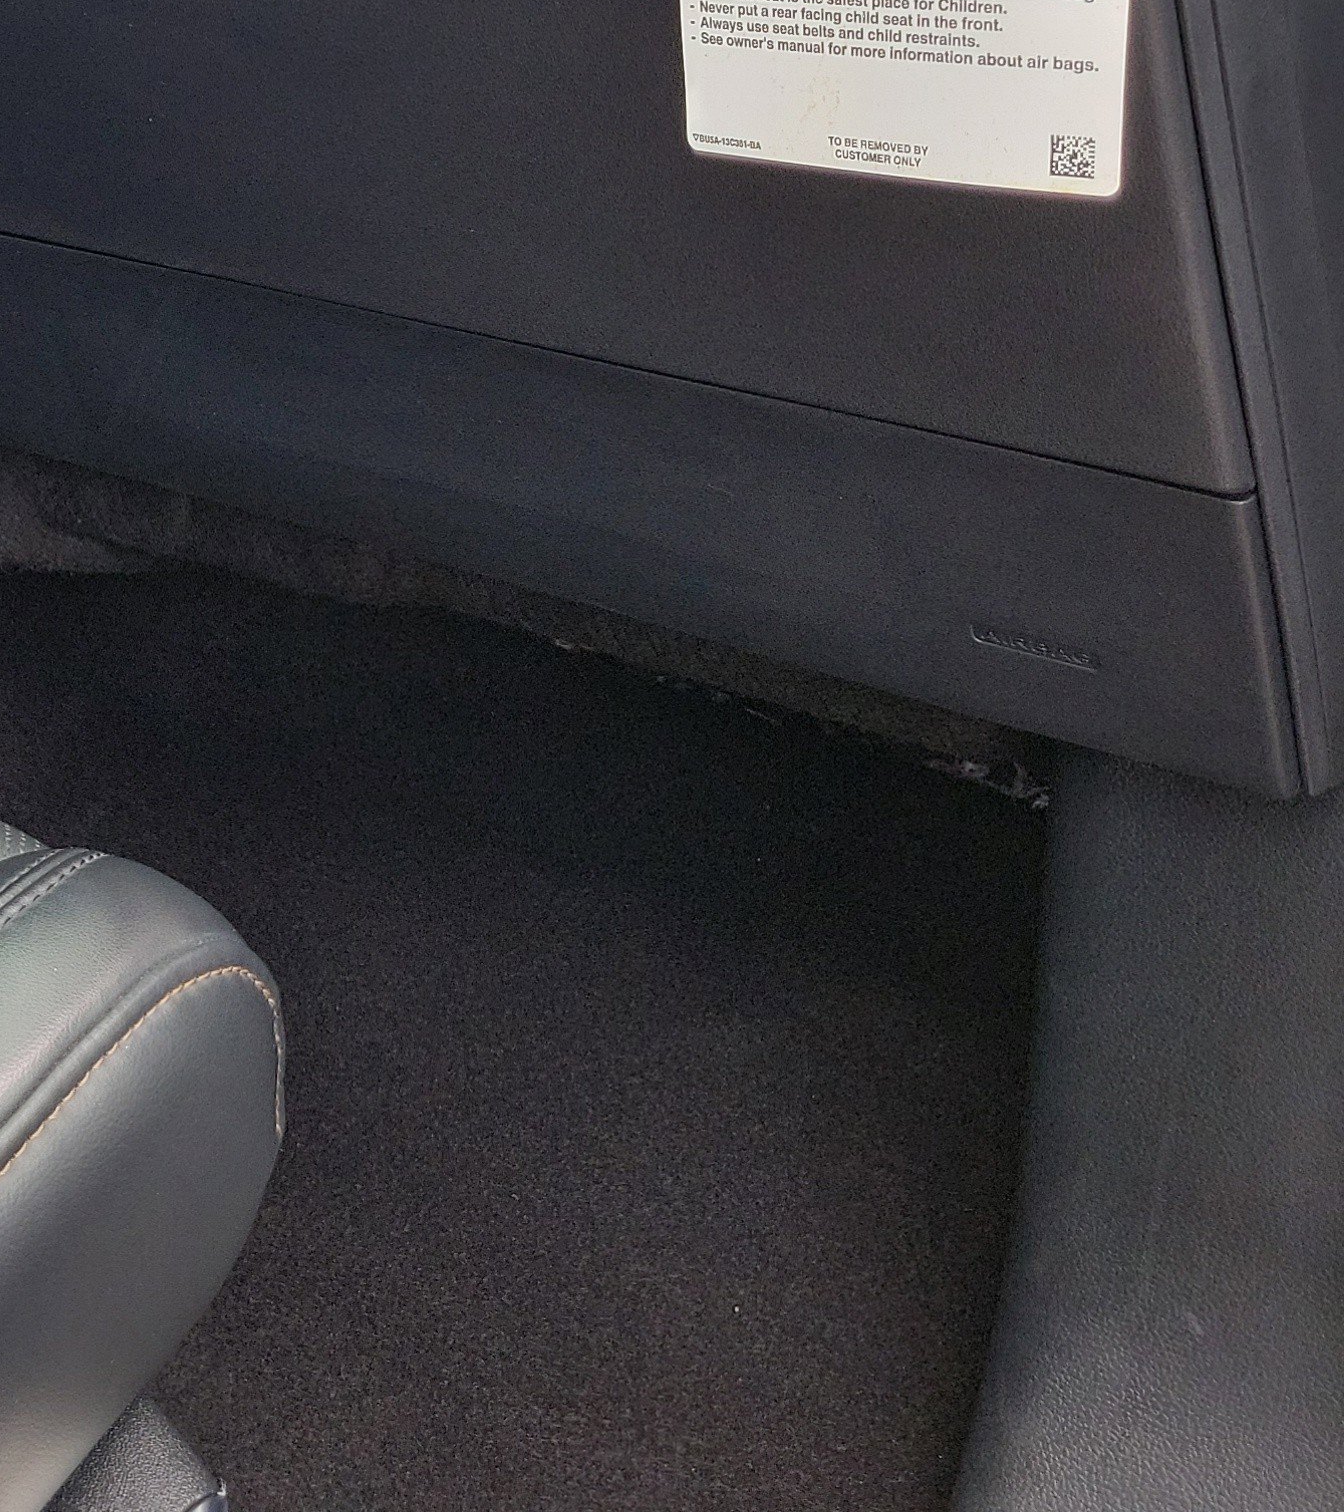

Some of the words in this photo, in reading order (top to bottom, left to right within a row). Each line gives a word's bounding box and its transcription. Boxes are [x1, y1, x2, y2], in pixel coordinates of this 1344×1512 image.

[699, 0, 734, 14] Never
[737, 5, 759, 18] put
[761, 7, 769, 17] a
[771, 8, 798, 19] rear
[801, 6, 842, 25] facing
[845, 9, 879, 24] child
[883, 12, 913, 26] seat
[916, 14, 930, 28] in
[934, 15, 957, 29] the
[962, 16, 1003, 32] front.
[700, 16, 744, 32] Always
[747, 22, 769, 33] use
[772, 23, 800, 36] seat
[803, 24, 835, 38] belts
[838, 26, 863, 40] and
[867, 28, 902, 43] child
[906, 32, 981, 48] restraints.
[701, 31, 723, 45] See
[726, 36, 774, 50] owner's
[777, 39, 825, 54] manual
[828, 41, 848, 55] for
[850, 46, 886, 59] more
[889, 45, 973, 65] information
[977, 52, 1023, 67] about
[1027, 54, 1049, 69] air
[1053, 56, 1100, 74] bags.
[828, 136, 842, 146] TO
[844, 138, 858, 148] BE
[860, 139, 912, 154] REMOVED
[914, 145, 928, 156] BY
[835, 149, 891, 164] CUSTOMER
[893, 156, 922, 167] ONLY
